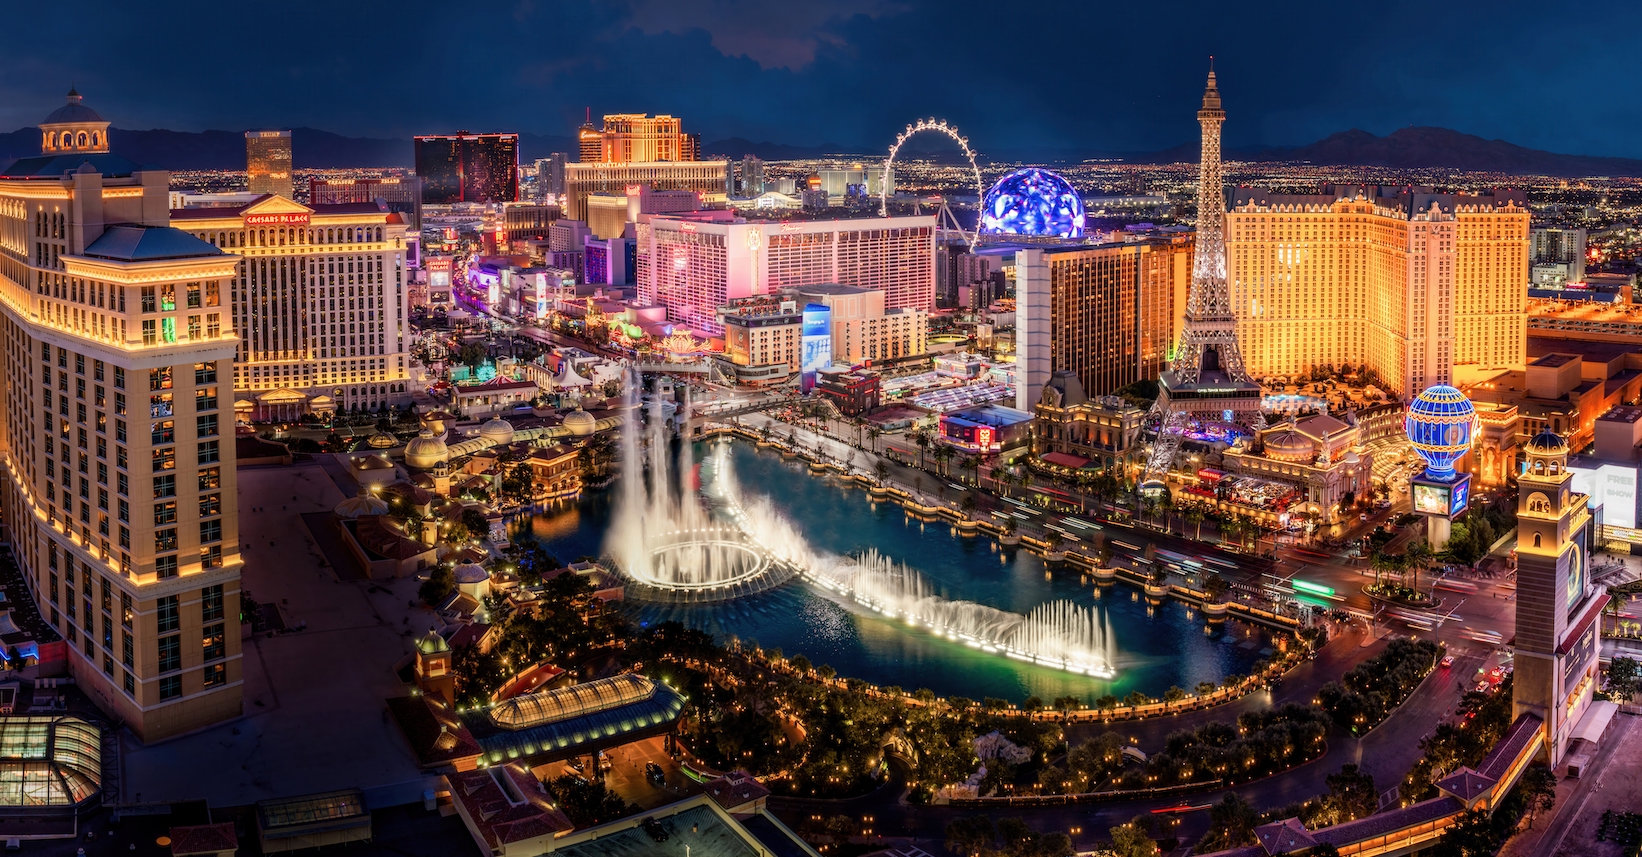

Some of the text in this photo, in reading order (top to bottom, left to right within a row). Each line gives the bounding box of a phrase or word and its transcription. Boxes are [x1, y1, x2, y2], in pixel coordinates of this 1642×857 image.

[781, 223, 802, 232] Flamingo
[1607, 474, 1634, 485] FREE
[1607, 489, 1634, 498] SHOW
